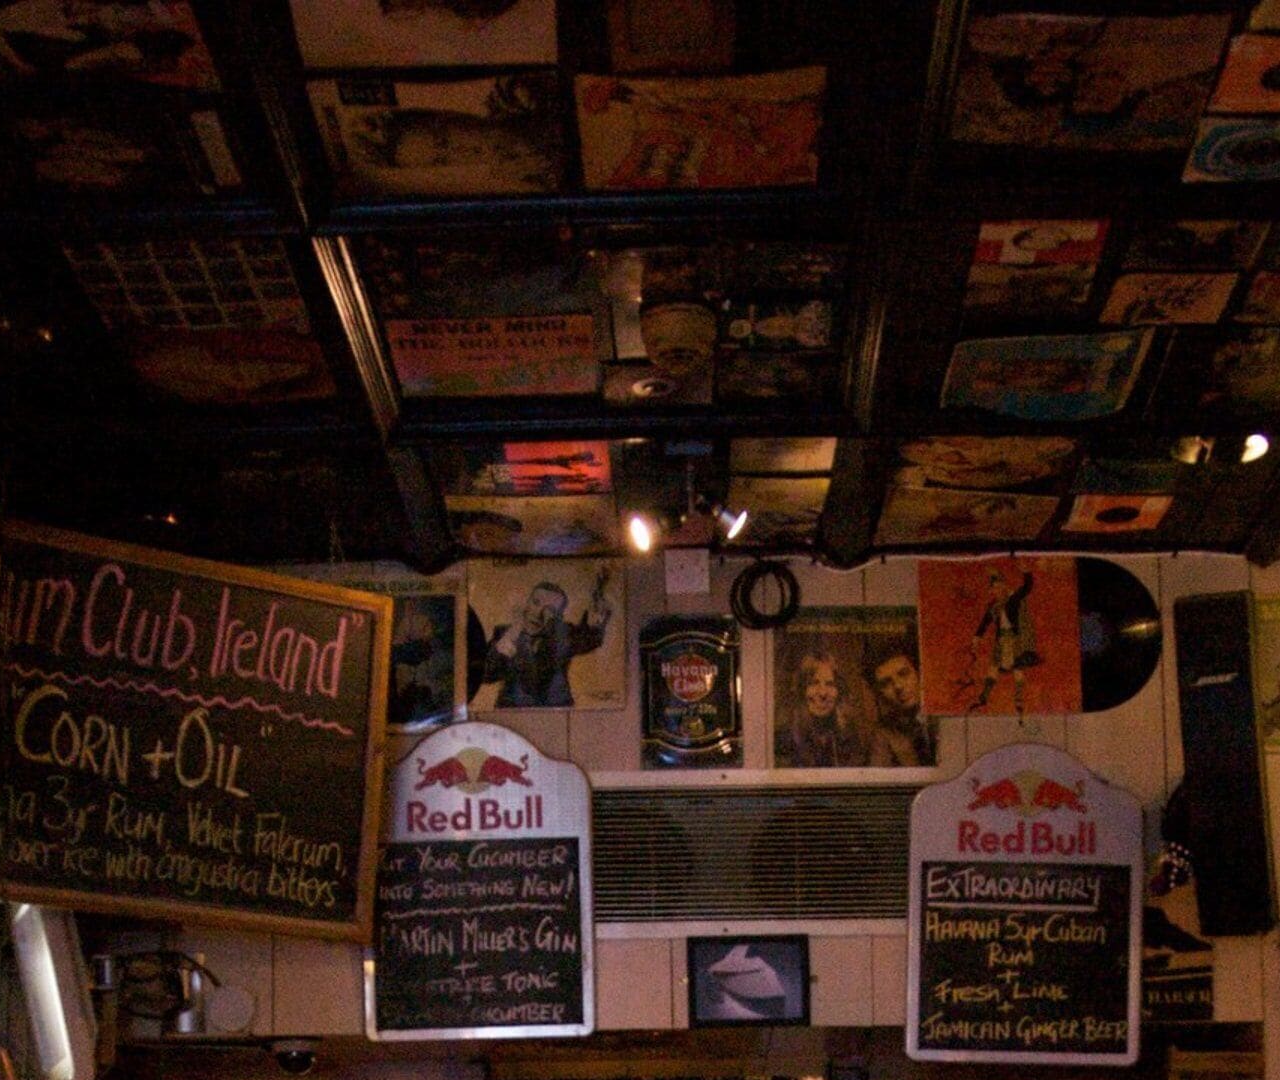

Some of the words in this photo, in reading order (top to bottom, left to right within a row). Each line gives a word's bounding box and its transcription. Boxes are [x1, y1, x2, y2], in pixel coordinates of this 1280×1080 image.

[407, 798, 471, 832] Red
[478, 795, 543, 830] Bull
[958, 820, 1024, 853] Red
[1031, 821, 1096, 854] Bull
